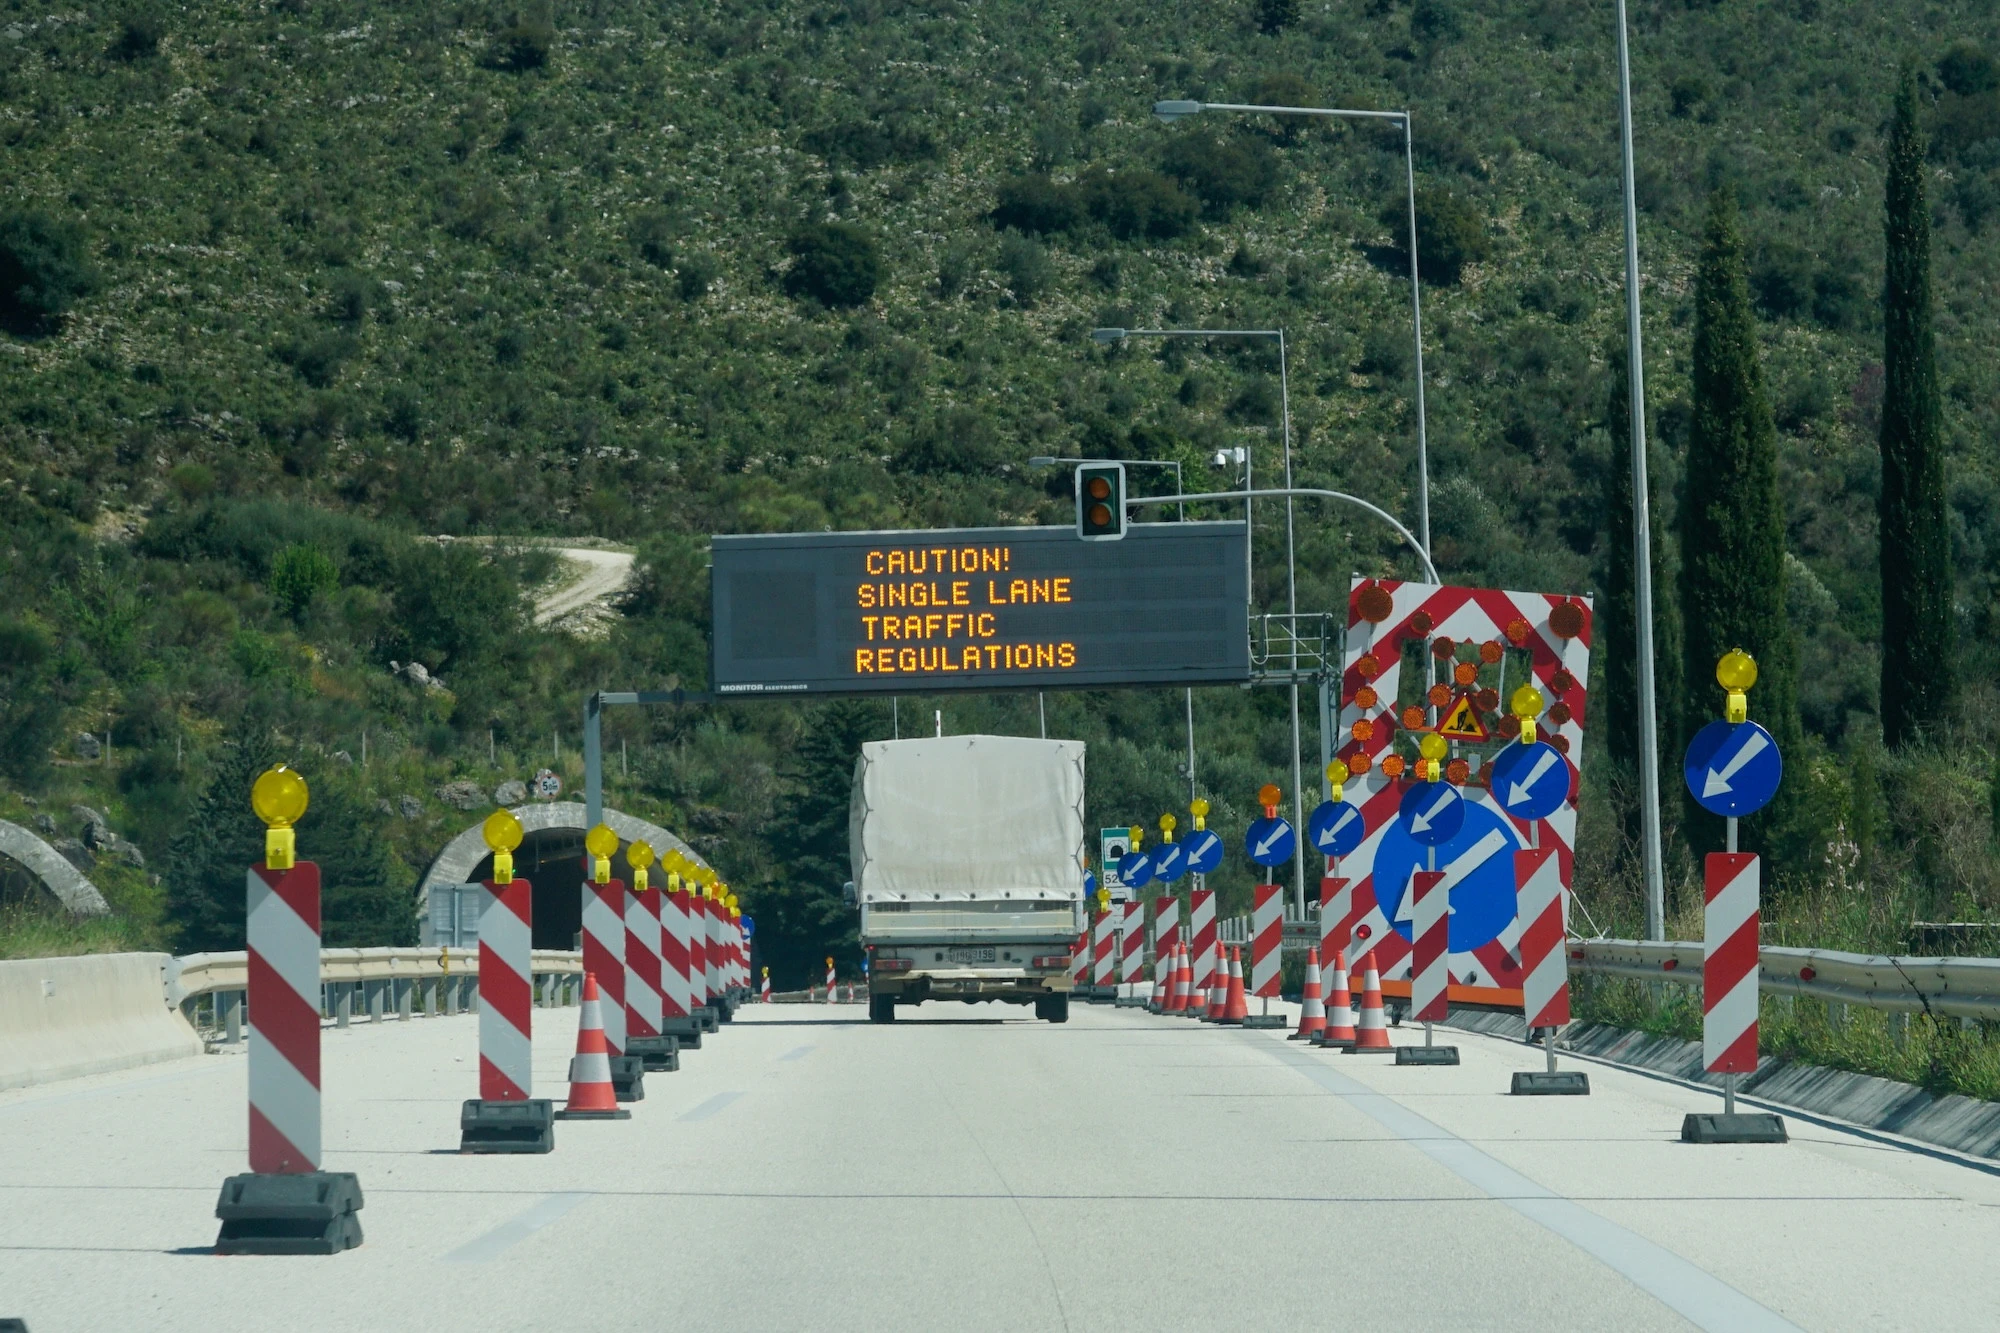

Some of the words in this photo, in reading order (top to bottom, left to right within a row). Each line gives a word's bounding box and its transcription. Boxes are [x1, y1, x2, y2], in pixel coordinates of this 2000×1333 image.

[866, 548, 1009, 575] CAUTION!
[858, 581, 970, 608] SINGLE
[989, 578, 1071, 604] LANE
[862, 613, 996, 640] TRAFFIC
[856, 644, 1075, 673] REGULATIONS
[720, 684, 763, 692] MONITOR
